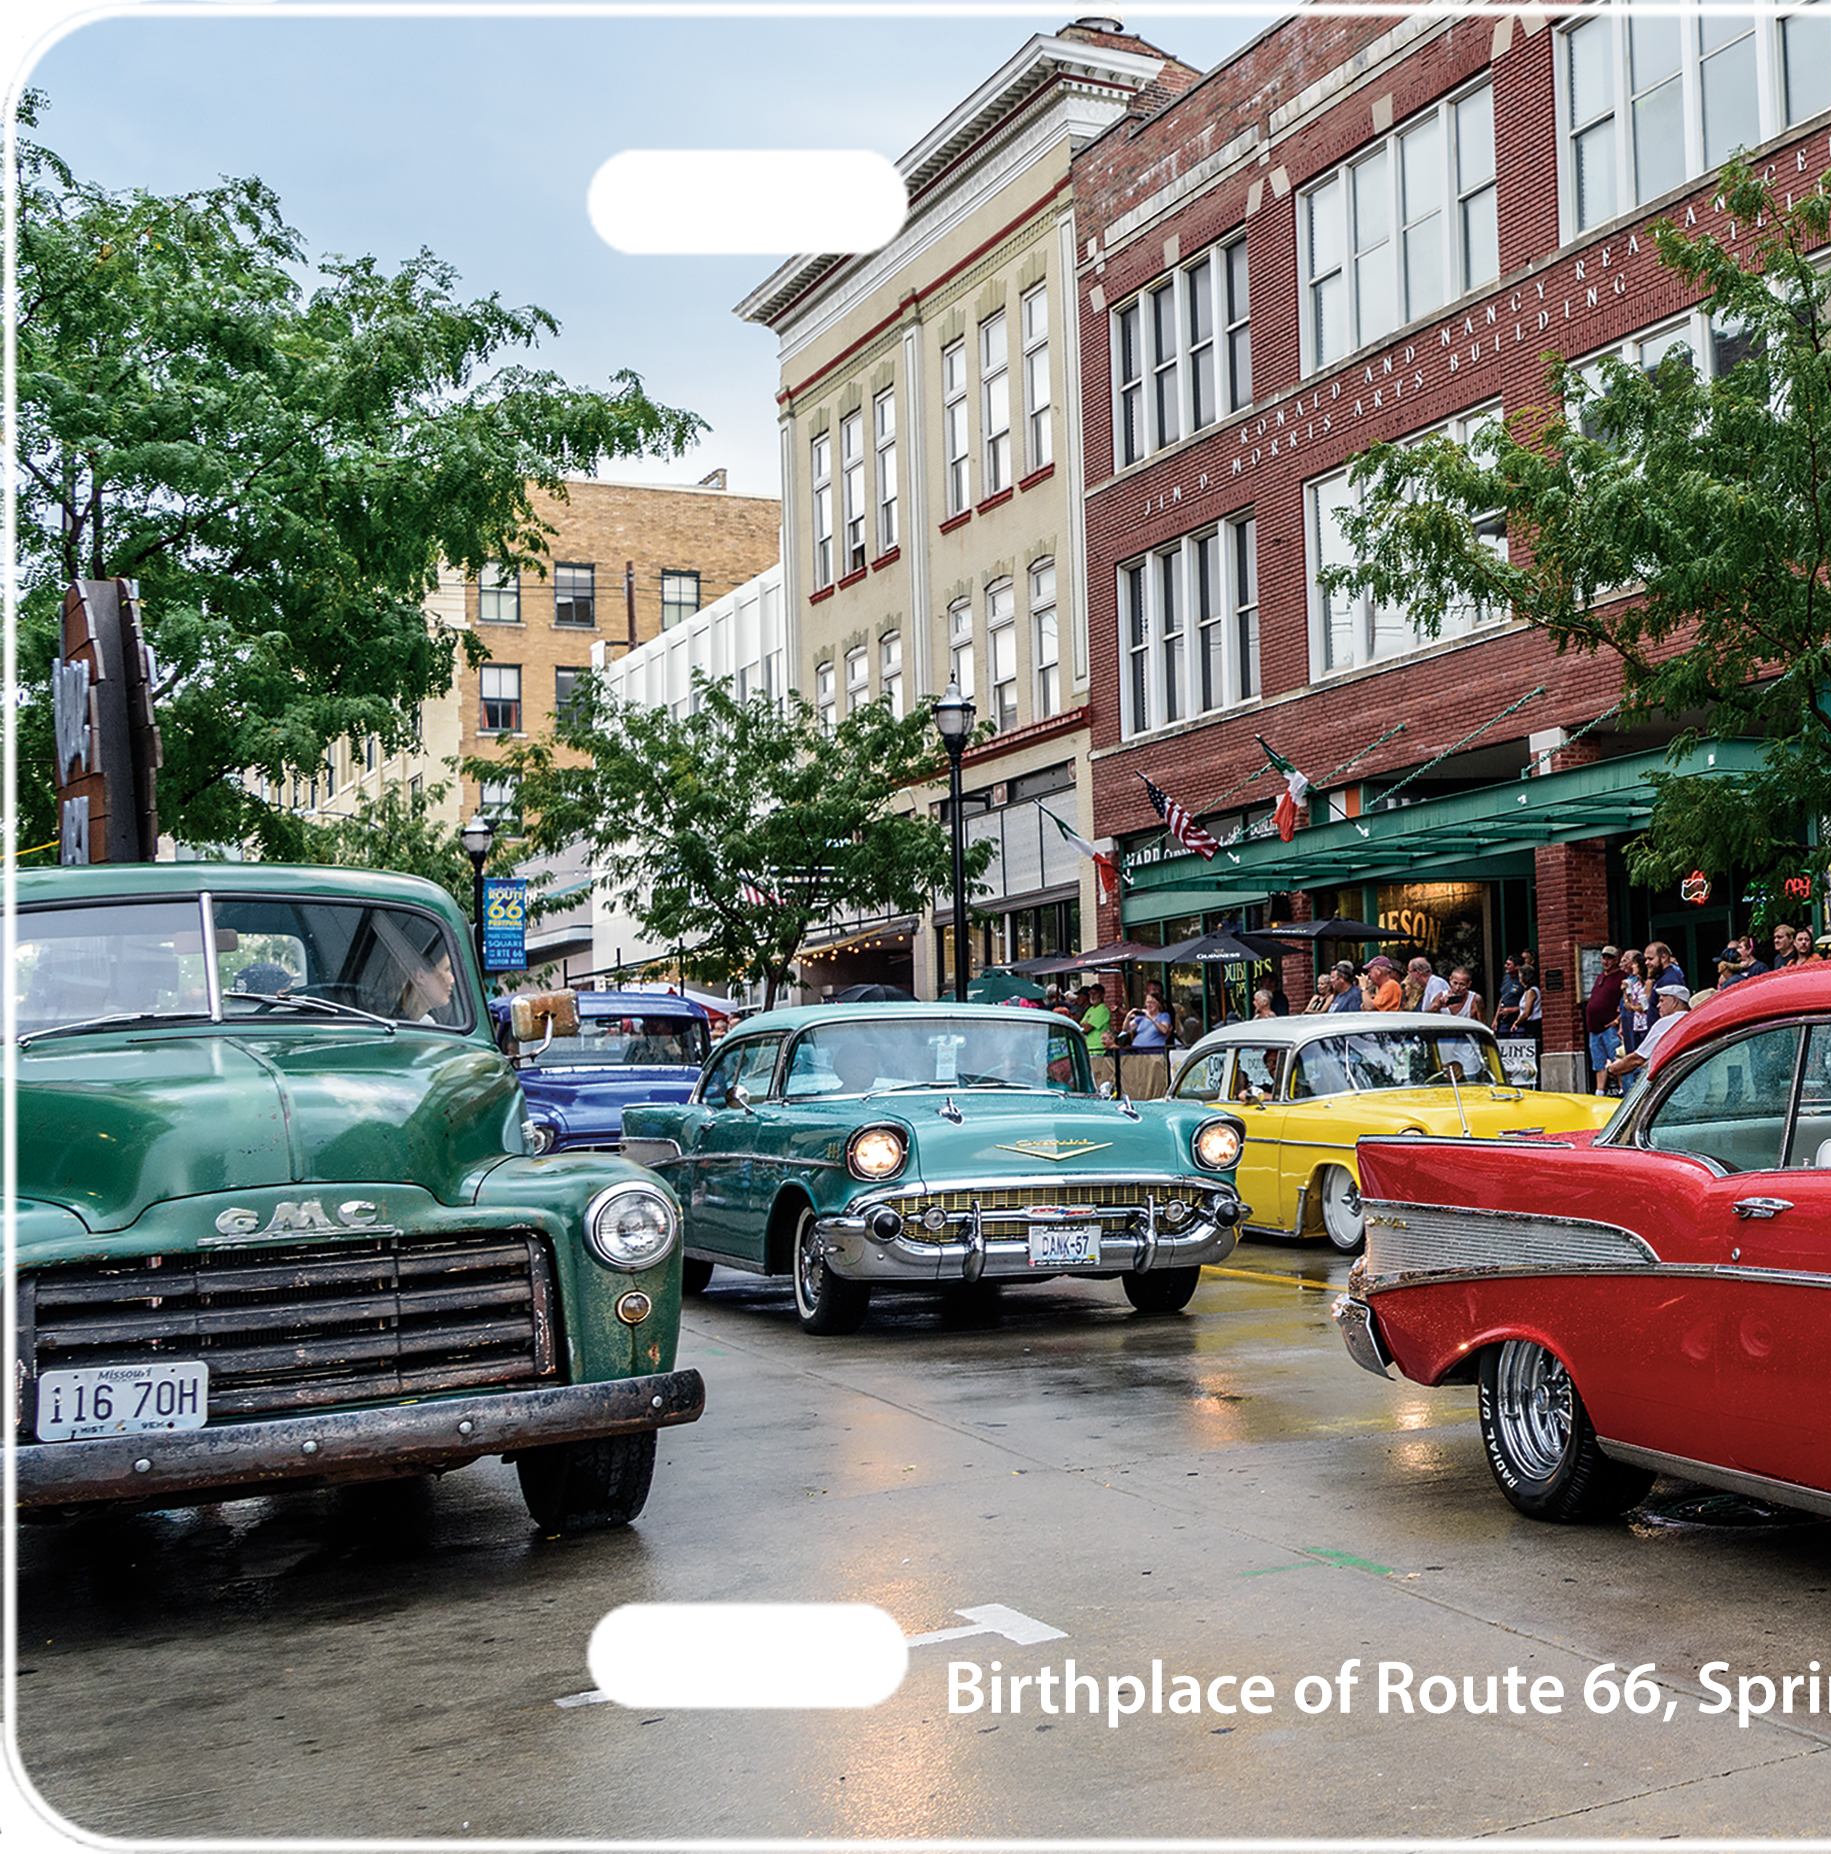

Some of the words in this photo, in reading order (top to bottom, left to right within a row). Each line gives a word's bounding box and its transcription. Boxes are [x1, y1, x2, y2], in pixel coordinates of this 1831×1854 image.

[1239, 382, 1341, 444] RONALD
[1364, 345, 1415, 384] AND
[1441, 280, 1545, 347] NANCY
[1576, 193, 1727, 281] REAAN
[1145, 486, 1182, 516] JIM
[1232, 414, 1331, 475] MORRIS
[1353, 370, 1423, 417] ARTS
[1450, 273, 1626, 373] BUILDING
[488, 890, 523, 900] ROUTE
[488, 899, 523, 919] 66
[1196, 952, 1241, 960] GUINNESS
[215, 1200, 377, 1235] GMC
[1042, 1235, 1090, 1256] DANK-57
[97, 1367, 151, 1381] Missouri
[1487, 1427, 1519, 1489] RADIAL
